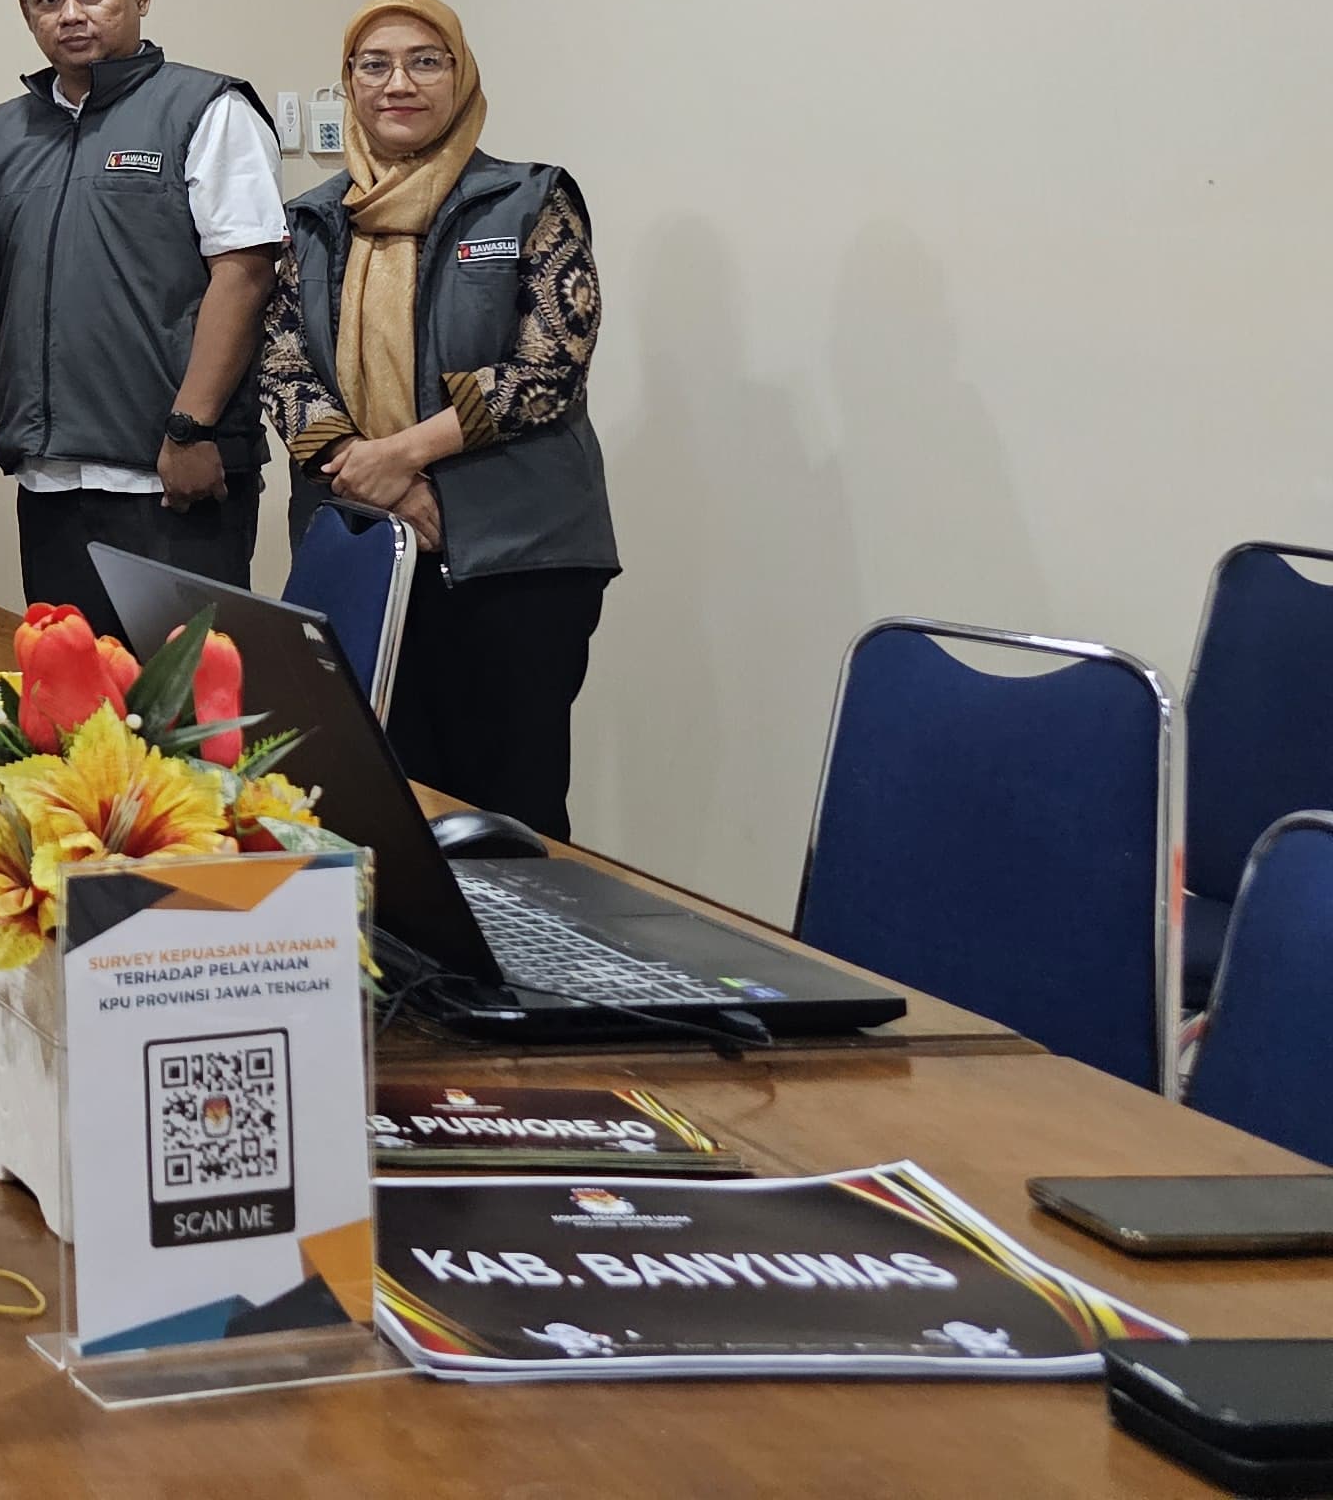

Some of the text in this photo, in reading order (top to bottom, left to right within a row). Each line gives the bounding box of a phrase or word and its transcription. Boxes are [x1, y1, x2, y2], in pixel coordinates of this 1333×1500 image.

[469, 241, 516, 254] BAWASLU
[89, 936, 337, 970] SURVEY KEPUASAN LAYANAN
[114, 956, 309, 986] TERHADAP PELAYANAN
[99, 978, 331, 1011] KPU PROVINSI JAWA TENGAH
[411, 1116, 657, 1140] PURWOREJO
[173, 1203, 275, 1236] SCAN ME
[411, 1247, 958, 1289] KAB. BANYUMAS
